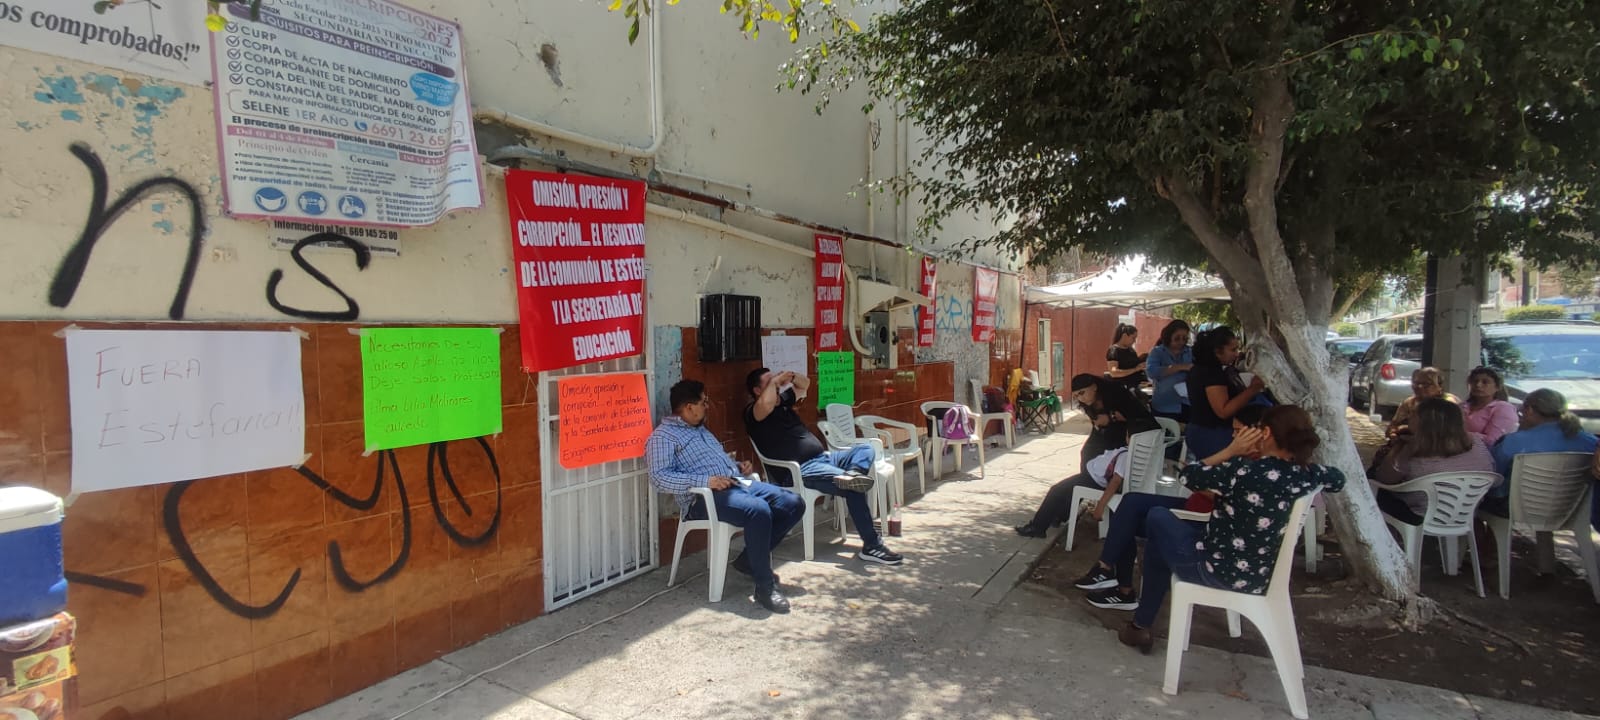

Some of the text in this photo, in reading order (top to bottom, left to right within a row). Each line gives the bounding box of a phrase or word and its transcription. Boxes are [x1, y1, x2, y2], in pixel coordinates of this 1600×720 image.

[305, 4, 336, 20] Escolar
[240, 25, 277, 41] CURP
[259, 14, 437, 72] EQUISITOS PARA PREINSCRIPCIÓN:
[294, 11, 372, 41] SECUNDARIA
[374, 35, 400, 50] SNTE
[242, 39, 409, 88] COPIA DE ACTA DE NACIMIENTO
[243, 51, 330, 80] COMPROBANTE
[332, 73, 346, 83] DE
[348, 77, 401, 97] DOMICILIO
[244, 63, 284, 80] COPIA
[287, 73, 308, 84] DEL
[309, 78, 328, 89] INE
[328, 84, 346, 95] DEL
[383, 96, 415, 111] MADRE
[416, 104, 425, 113] O
[246, 76, 323, 100] CONSTANCIA
[326, 93, 341, 104] DE
[341, 97, 386, 114] ESTUDIOS
[387, 107, 400, 118] DE
[417, 114, 436, 126] AÑO
[242, 99, 291, 117] SELENE
[296, 109, 317, 120] 1ER
[321, 112, 349, 127] AÑO
[409, 130, 424, 144] 23
[249, 88, 271, 99] PARA
[273, 93, 304, 105] MAYOR
[305, 99, 358, 117] INFORMACIÓN
[360, 111, 382, 121] FAVOR
[383, 116, 392, 124] DE
[232, 115, 242, 124] El
[244, 119, 286, 131] proceso
[288, 124, 301, 133] de
[303, 127, 368, 145] preinscripción
[238, 139, 285, 154] Principio
[286, 144, 297, 154] de
[299, 147, 328, 158] Orden
[532, 177, 629, 210] OMISIÓN, OPRESIÓN Y
[274, 220, 325, 233] Información
[365, 229, 378, 238] 145
[379, 230, 388, 239] 25
[590, 223, 601, 246] EL
[521, 261, 537, 288] DE
[537, 260, 550, 287] LA
[549, 255, 602, 286] COMUNIÓN
[600, 258, 615, 283] DE
[551, 300, 559, 325] Y
[559, 299, 572, 325] LA
[571, 290, 632, 323] SECRETARÍA
[572, 325, 635, 361] EDUCACIÓN.
